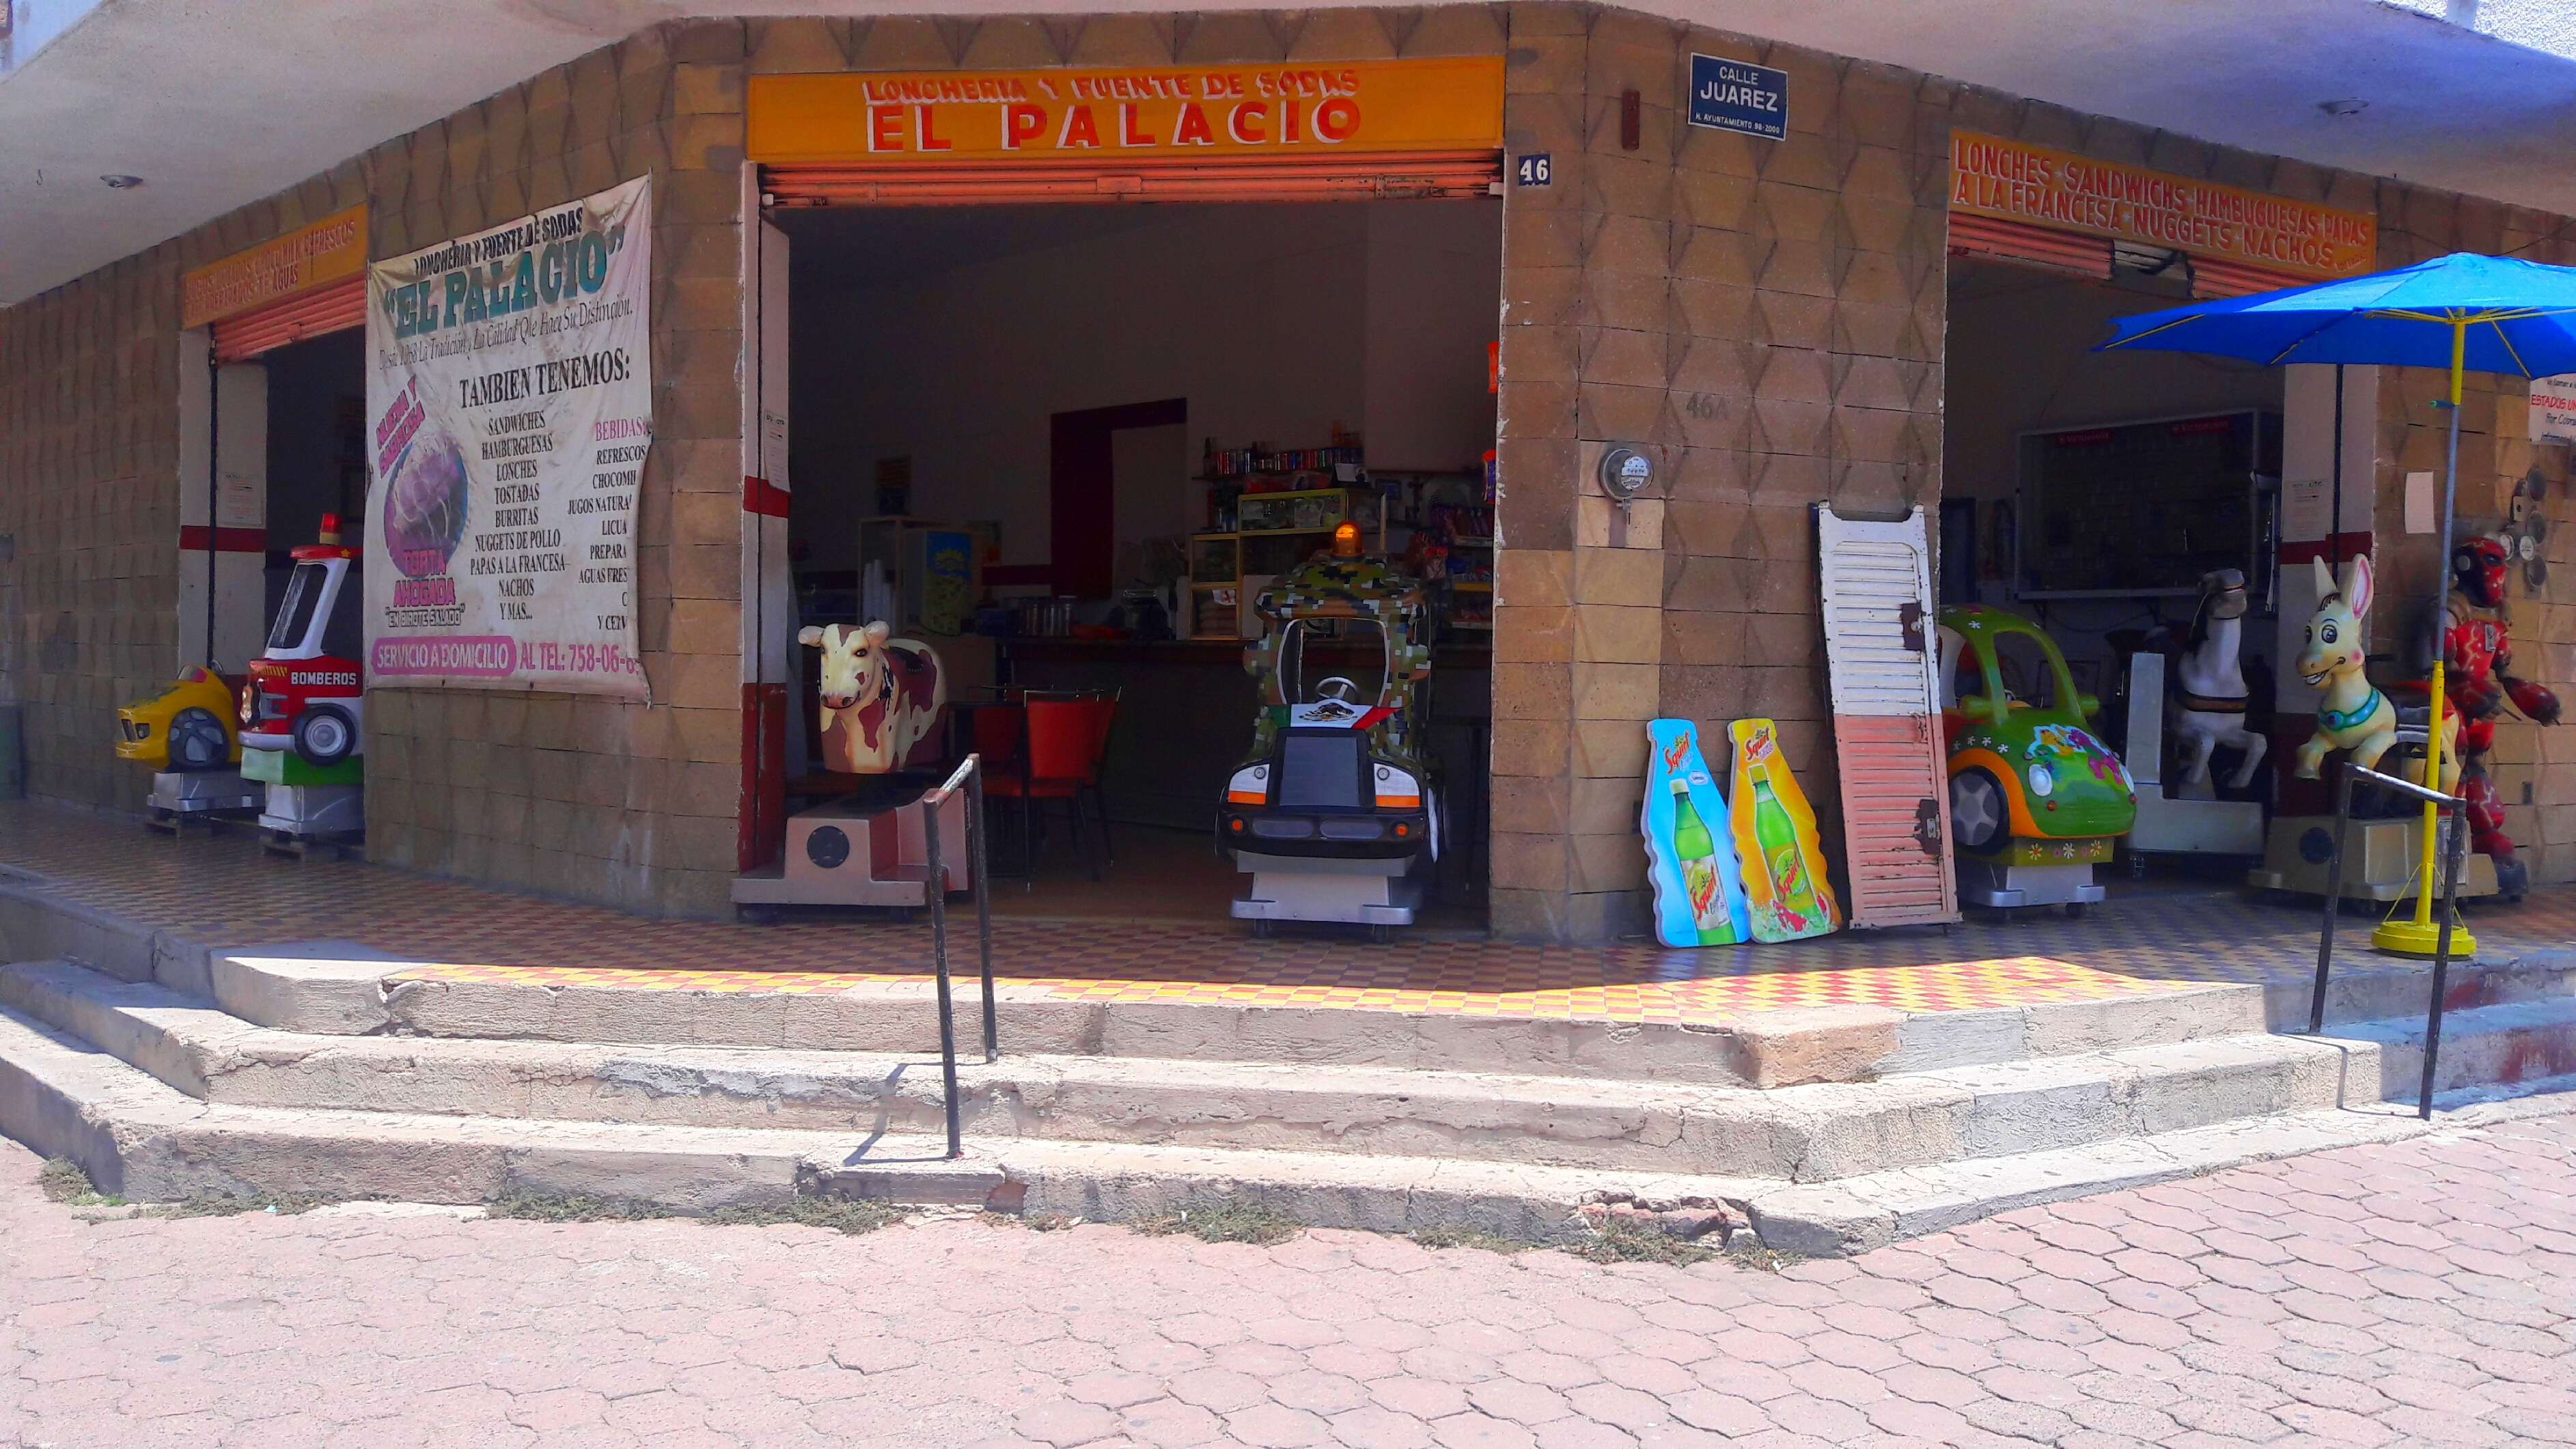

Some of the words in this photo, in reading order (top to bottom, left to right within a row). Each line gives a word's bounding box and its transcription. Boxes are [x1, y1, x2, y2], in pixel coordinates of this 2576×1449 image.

[861, 77, 1027, 105] LONCHERIA
[1038, 77, 1060, 102] Y
[1070, 72, 1193, 100] FUENTE
[1202, 72, 1245, 100] DE
[1256, 69, 1362, 98] SODAS
[1719, 66, 1759, 86] CALLE
[1700, 81, 1778, 113] JUAREZ
[866, 104, 953, 153] EL
[1001, 98, 1362, 151] PALACIO
[1695, 111, 1702, 122] H.
[1703, 113, 1752, 129] AYUNTAMIENTO
[1519, 158, 1549, 182] 46
[1954, 138, 2052, 187] LONCHES
[2064, 161, 2186, 213] SANDWICHS
[2193, 187, 2318, 238] HAMBUGUESAS
[2323, 213, 2369, 247] PAPAS
[1952, 173, 1970, 206] A
[1976, 176, 2006, 212] LA
[2010, 183, 2122, 232] FRANCESA
[2132, 206, 2232, 251] NUGGETS
[2241, 226, 2333, 270] NACHOS
[473, 240, 481, 263] Y
[482, 226, 524, 260] FUENTE
[525, 221, 540, 247] DE
[542, 207, 583, 241] SODAS
[419, 341, 428, 362] La
[564, 306, 576, 331] Su
[460, 366, 531, 409] TAMBIEN
[536, 346, 631, 396] TENEMOS:
[2531, 394, 2566, 410] ESTADOS
[488, 411, 545, 436] SANDWICHES
[481, 434, 553, 460] HAMBURGUESAS
[596, 445, 646, 465] REFRESCOS
[496, 460, 538, 482] LONCHES
[495, 484, 540, 505] TOSTADAS
[567, 498, 594, 514] JUGOS
[495, 507, 539, 528] BURRITAS
[475, 532, 515, 552] NUGGETS
[516, 532, 528, 549] DE
[529, 529, 561, 549] POLLO
[404, 549, 447, 577] TORTA
[470, 557, 497, 576] PAPAS
[497, 556, 505, 573] A
[505, 555, 518, 572] LA
[518, 553, 565, 572] FRANCESA
[578, 568, 606, 584] AGUAS
[393, 577, 456, 607] AHOGADA
[499, 579, 534, 598] NACHOS
[500, 603, 506, 620] Y
[598, 616, 604, 631] Y
[376, 644, 428, 669] SERVICIO
[430, 644, 440, 668] A
[441, 643, 509, 670] DOMICILIO
[519, 642, 536, 670] AL
[539, 642, 565, 671] TEL:
[568, 644, 639, 676] 758-06-
[290, 670, 357, 686] BOMBEROS
